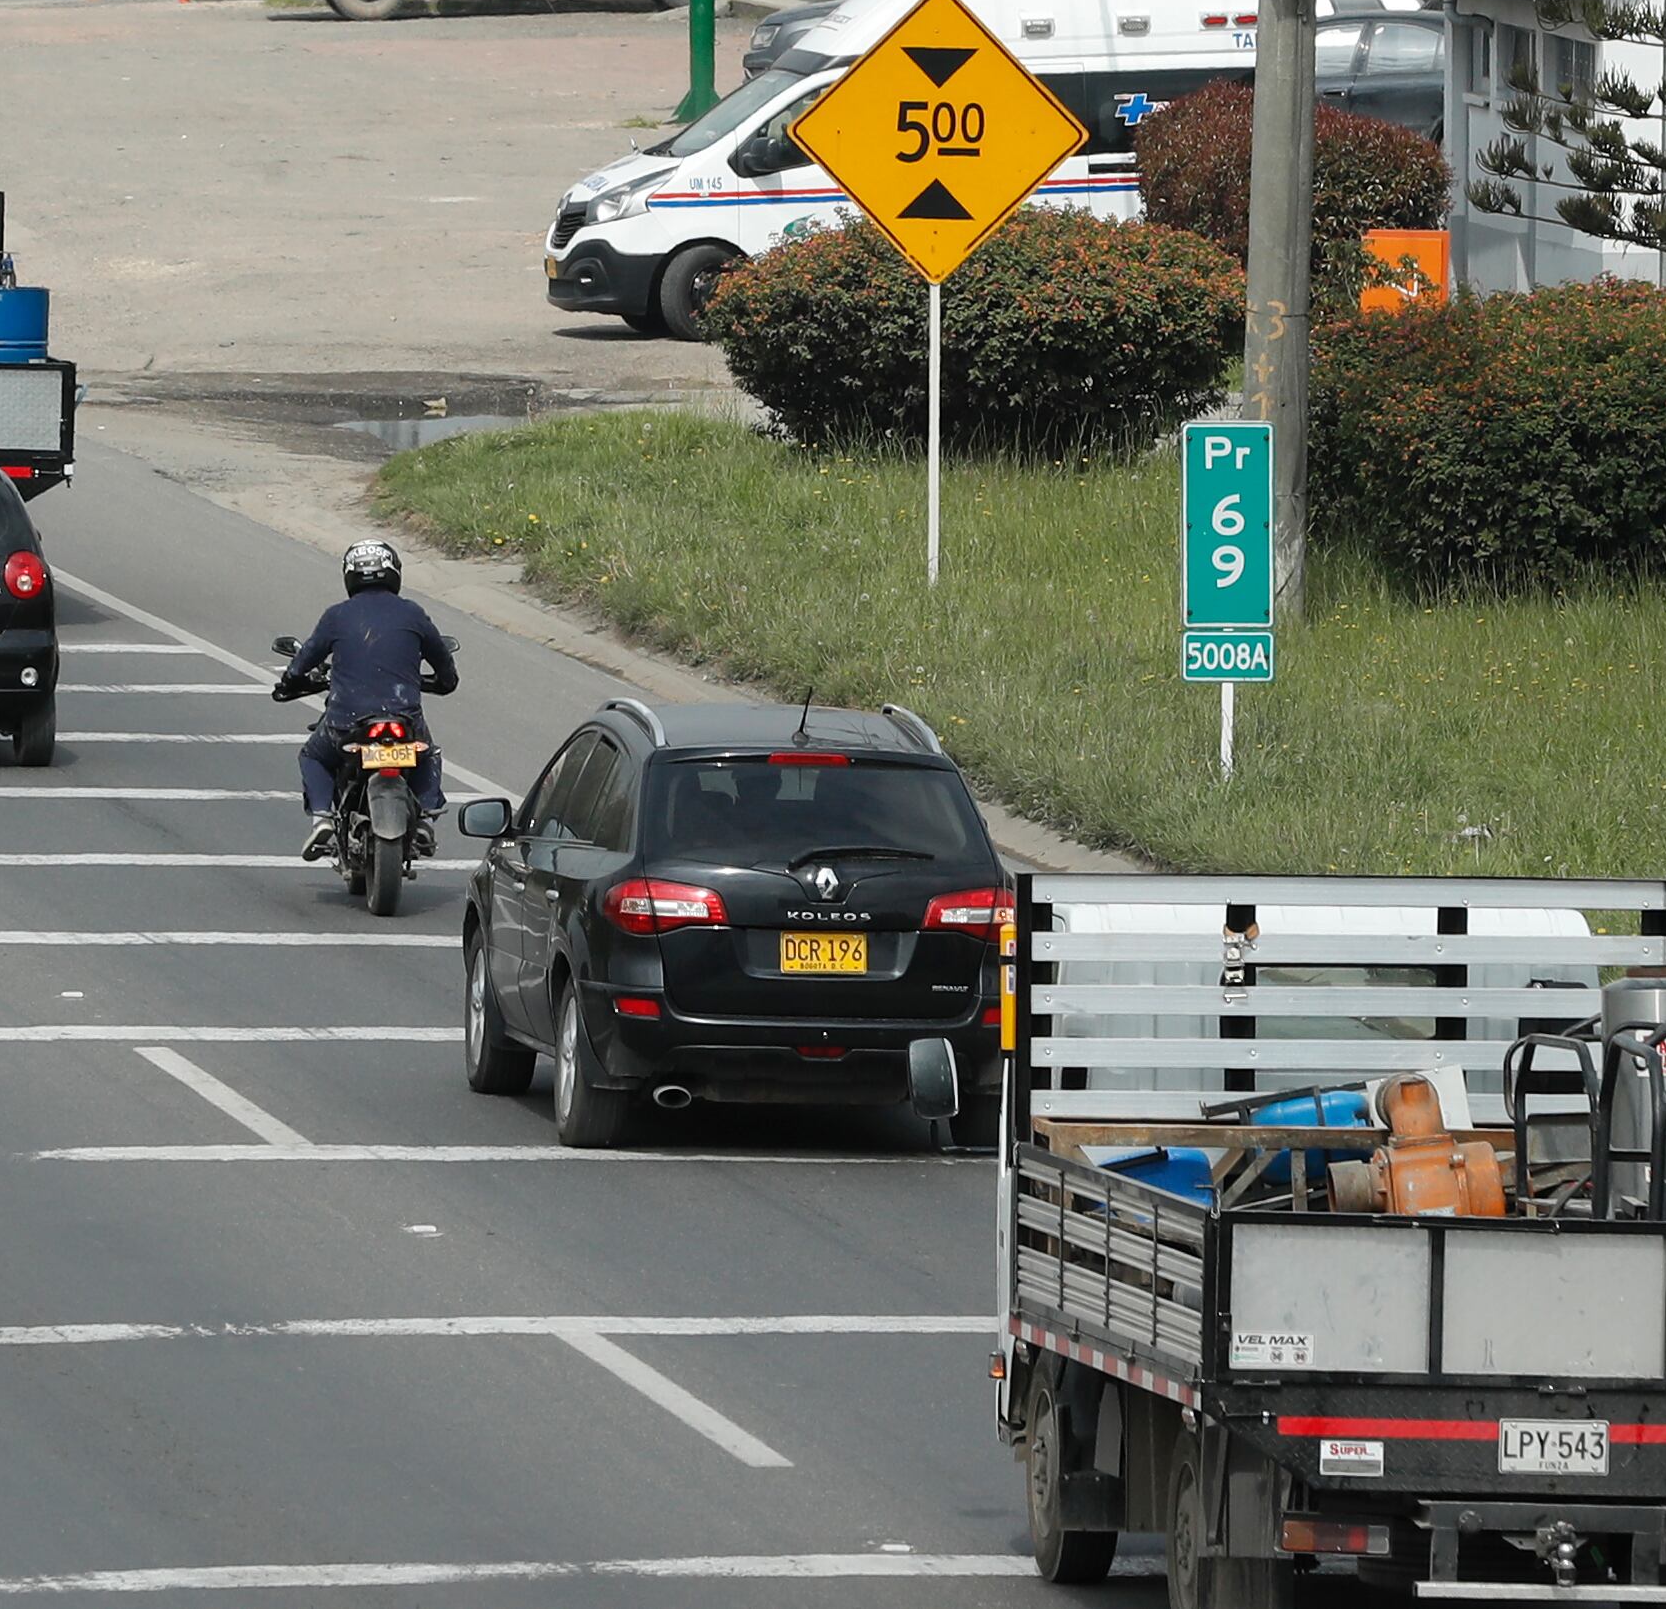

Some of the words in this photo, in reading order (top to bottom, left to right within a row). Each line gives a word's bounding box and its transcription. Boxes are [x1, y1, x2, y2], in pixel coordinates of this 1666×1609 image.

[1233, 33, 1257, 48] TA
[689, 177, 704, 190] UM
[706, 177, 722, 191] 145
[1204, 436, 1251, 470] Pr
[1211, 493, 1245, 536] 6
[1211, 545, 1245, 589] 9
[1187, 642, 1268, 671] 5008A
[786, 910, 872, 922] KOLEOS
[800, 962, 827, 970] BOGOTA
[1237, 1334, 1266, 1345] VEL
[1269, 1335, 1307, 1346] MAX
[1539, 1461, 1569, 1470] FUNZA
